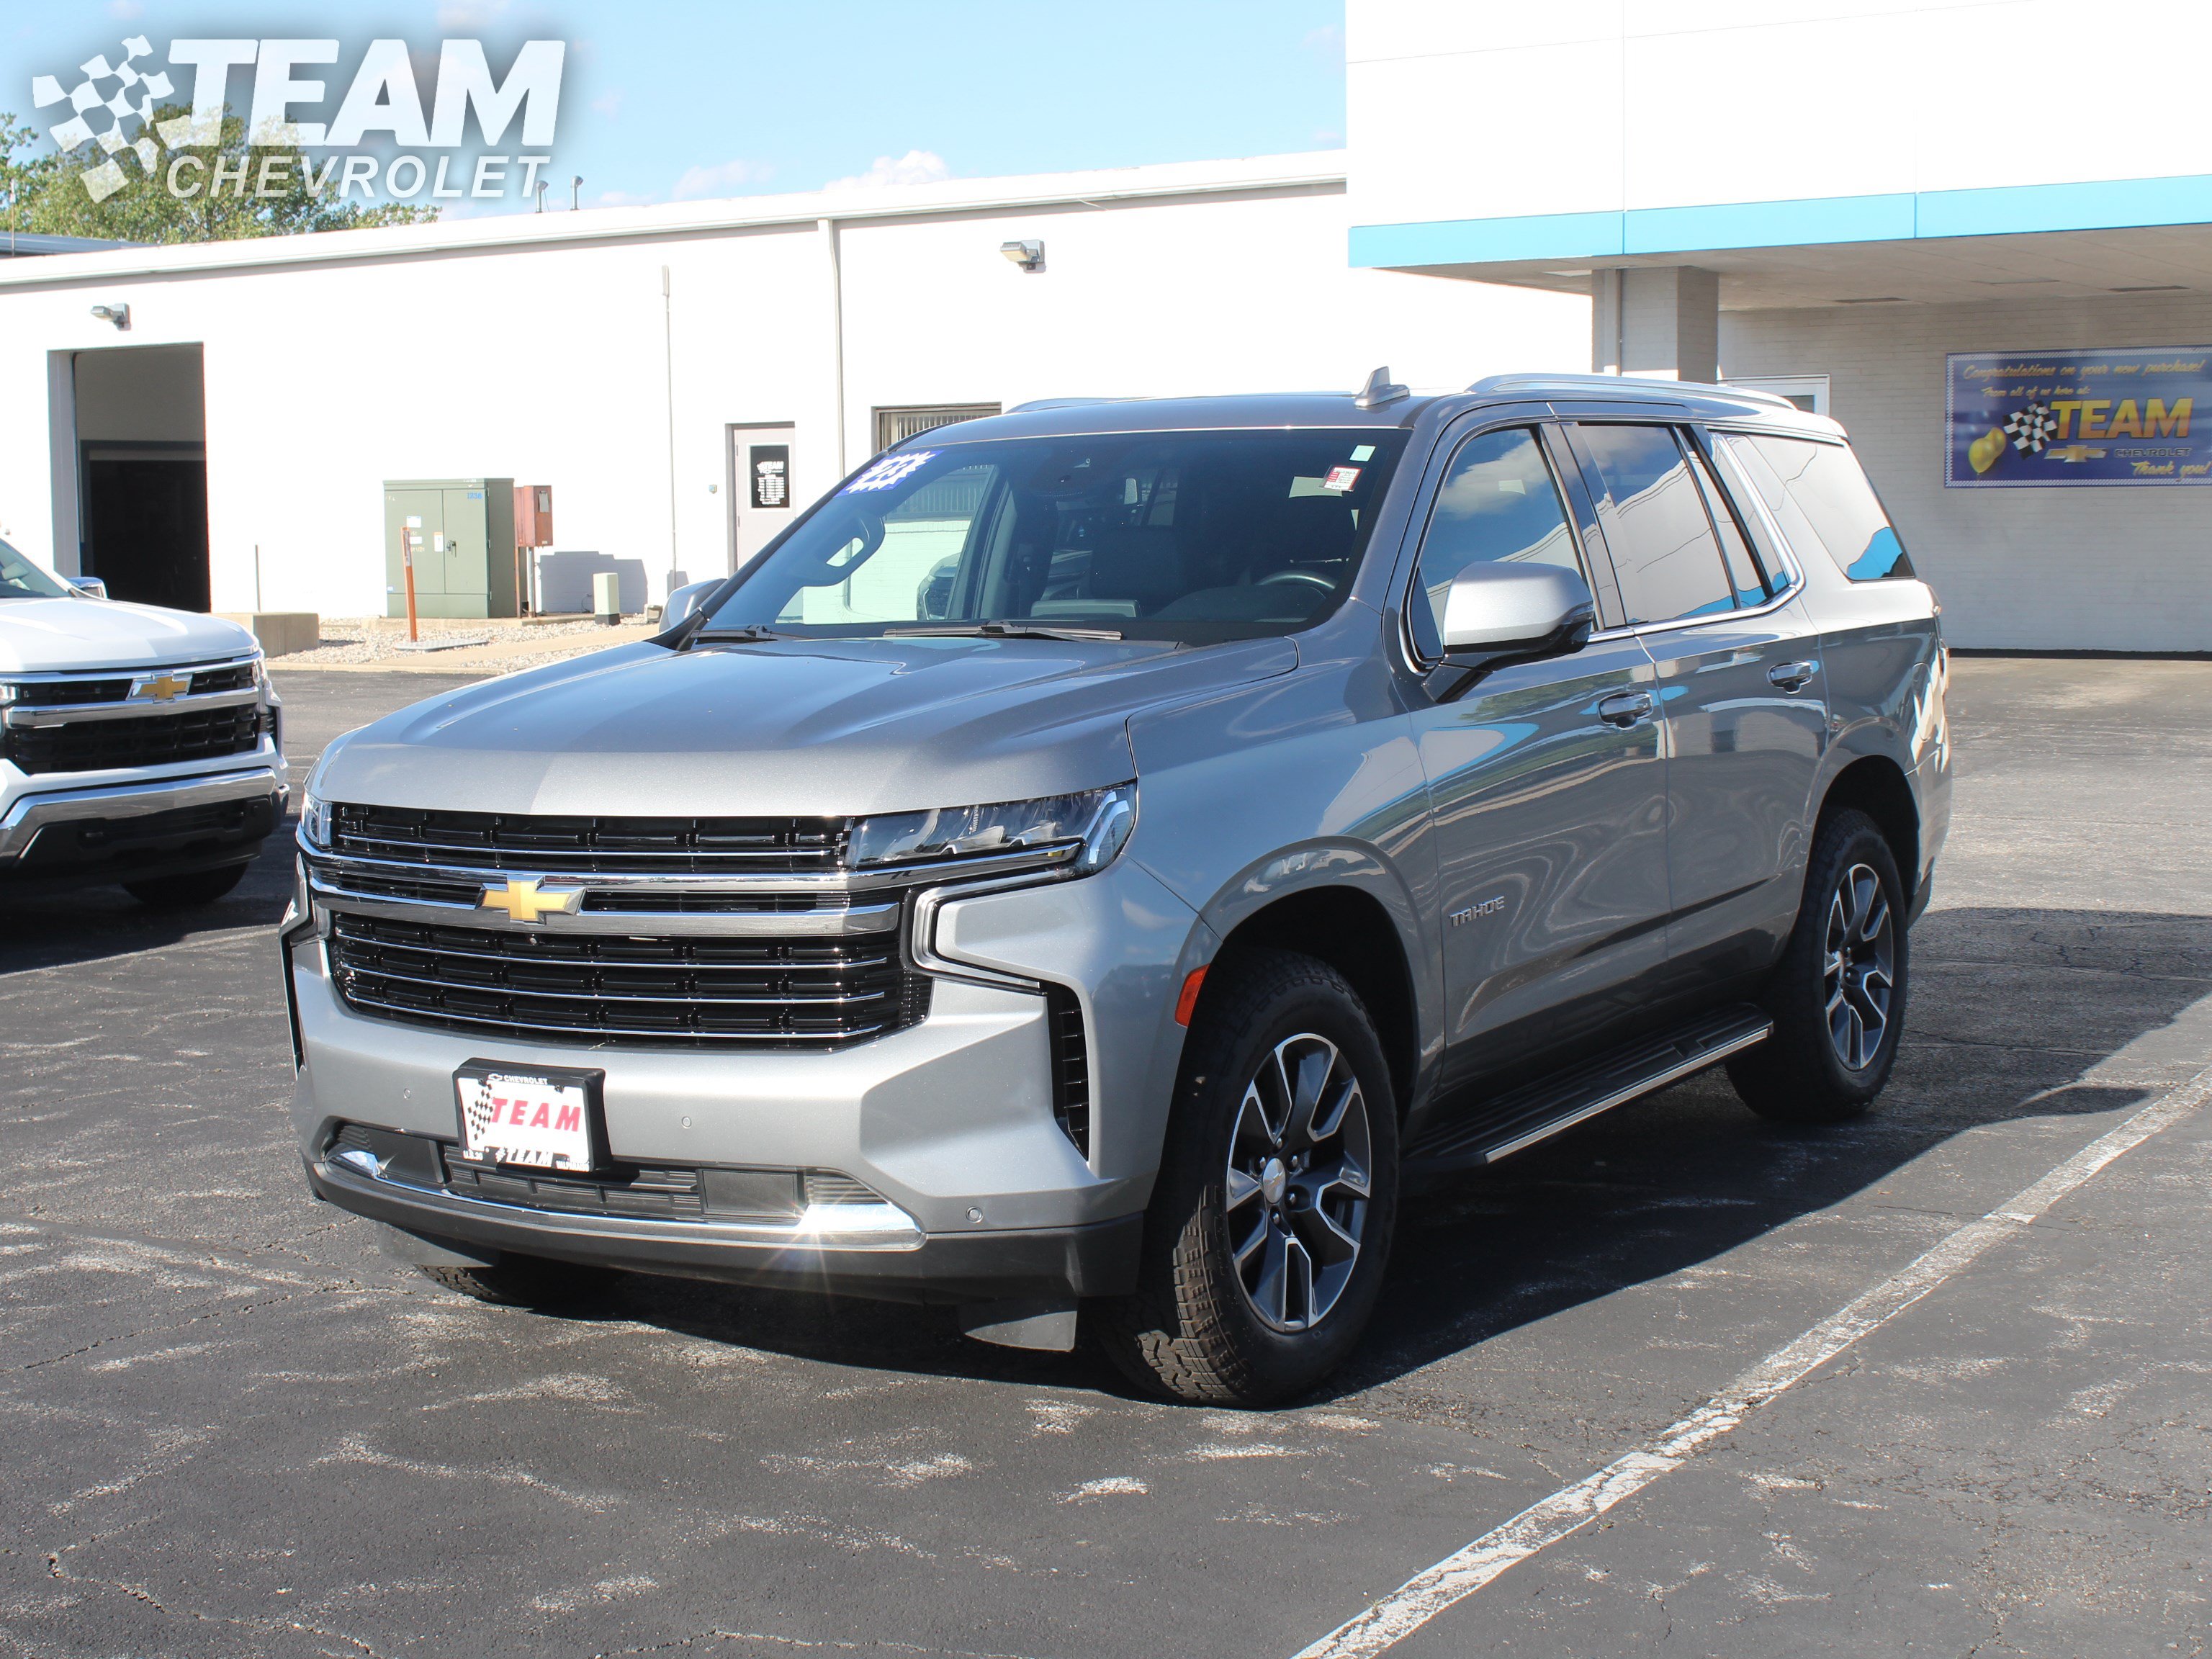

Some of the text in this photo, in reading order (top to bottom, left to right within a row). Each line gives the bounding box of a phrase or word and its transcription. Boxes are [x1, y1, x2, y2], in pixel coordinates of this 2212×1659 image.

[1963, 359, 2206, 383] Congratulations on your new purchase!
[1981, 386, 2008, 397] From
[2010, 385, 2025, 397] all
[2026, 386, 2039, 400] of
[2054, 385, 2074, 395] here
[2050, 397, 2194, 440] TEAM
[2114, 447, 2193, 458] CHEVROLET
[2130, 459, 2212, 482] Thank you!
[1449, 895, 1506, 927] TAHOE
[503, 1075, 548, 1085] CHEVROLET
[491, 1097, 581, 1132] TEAM
[505, 1147, 554, 1167] TEAM
